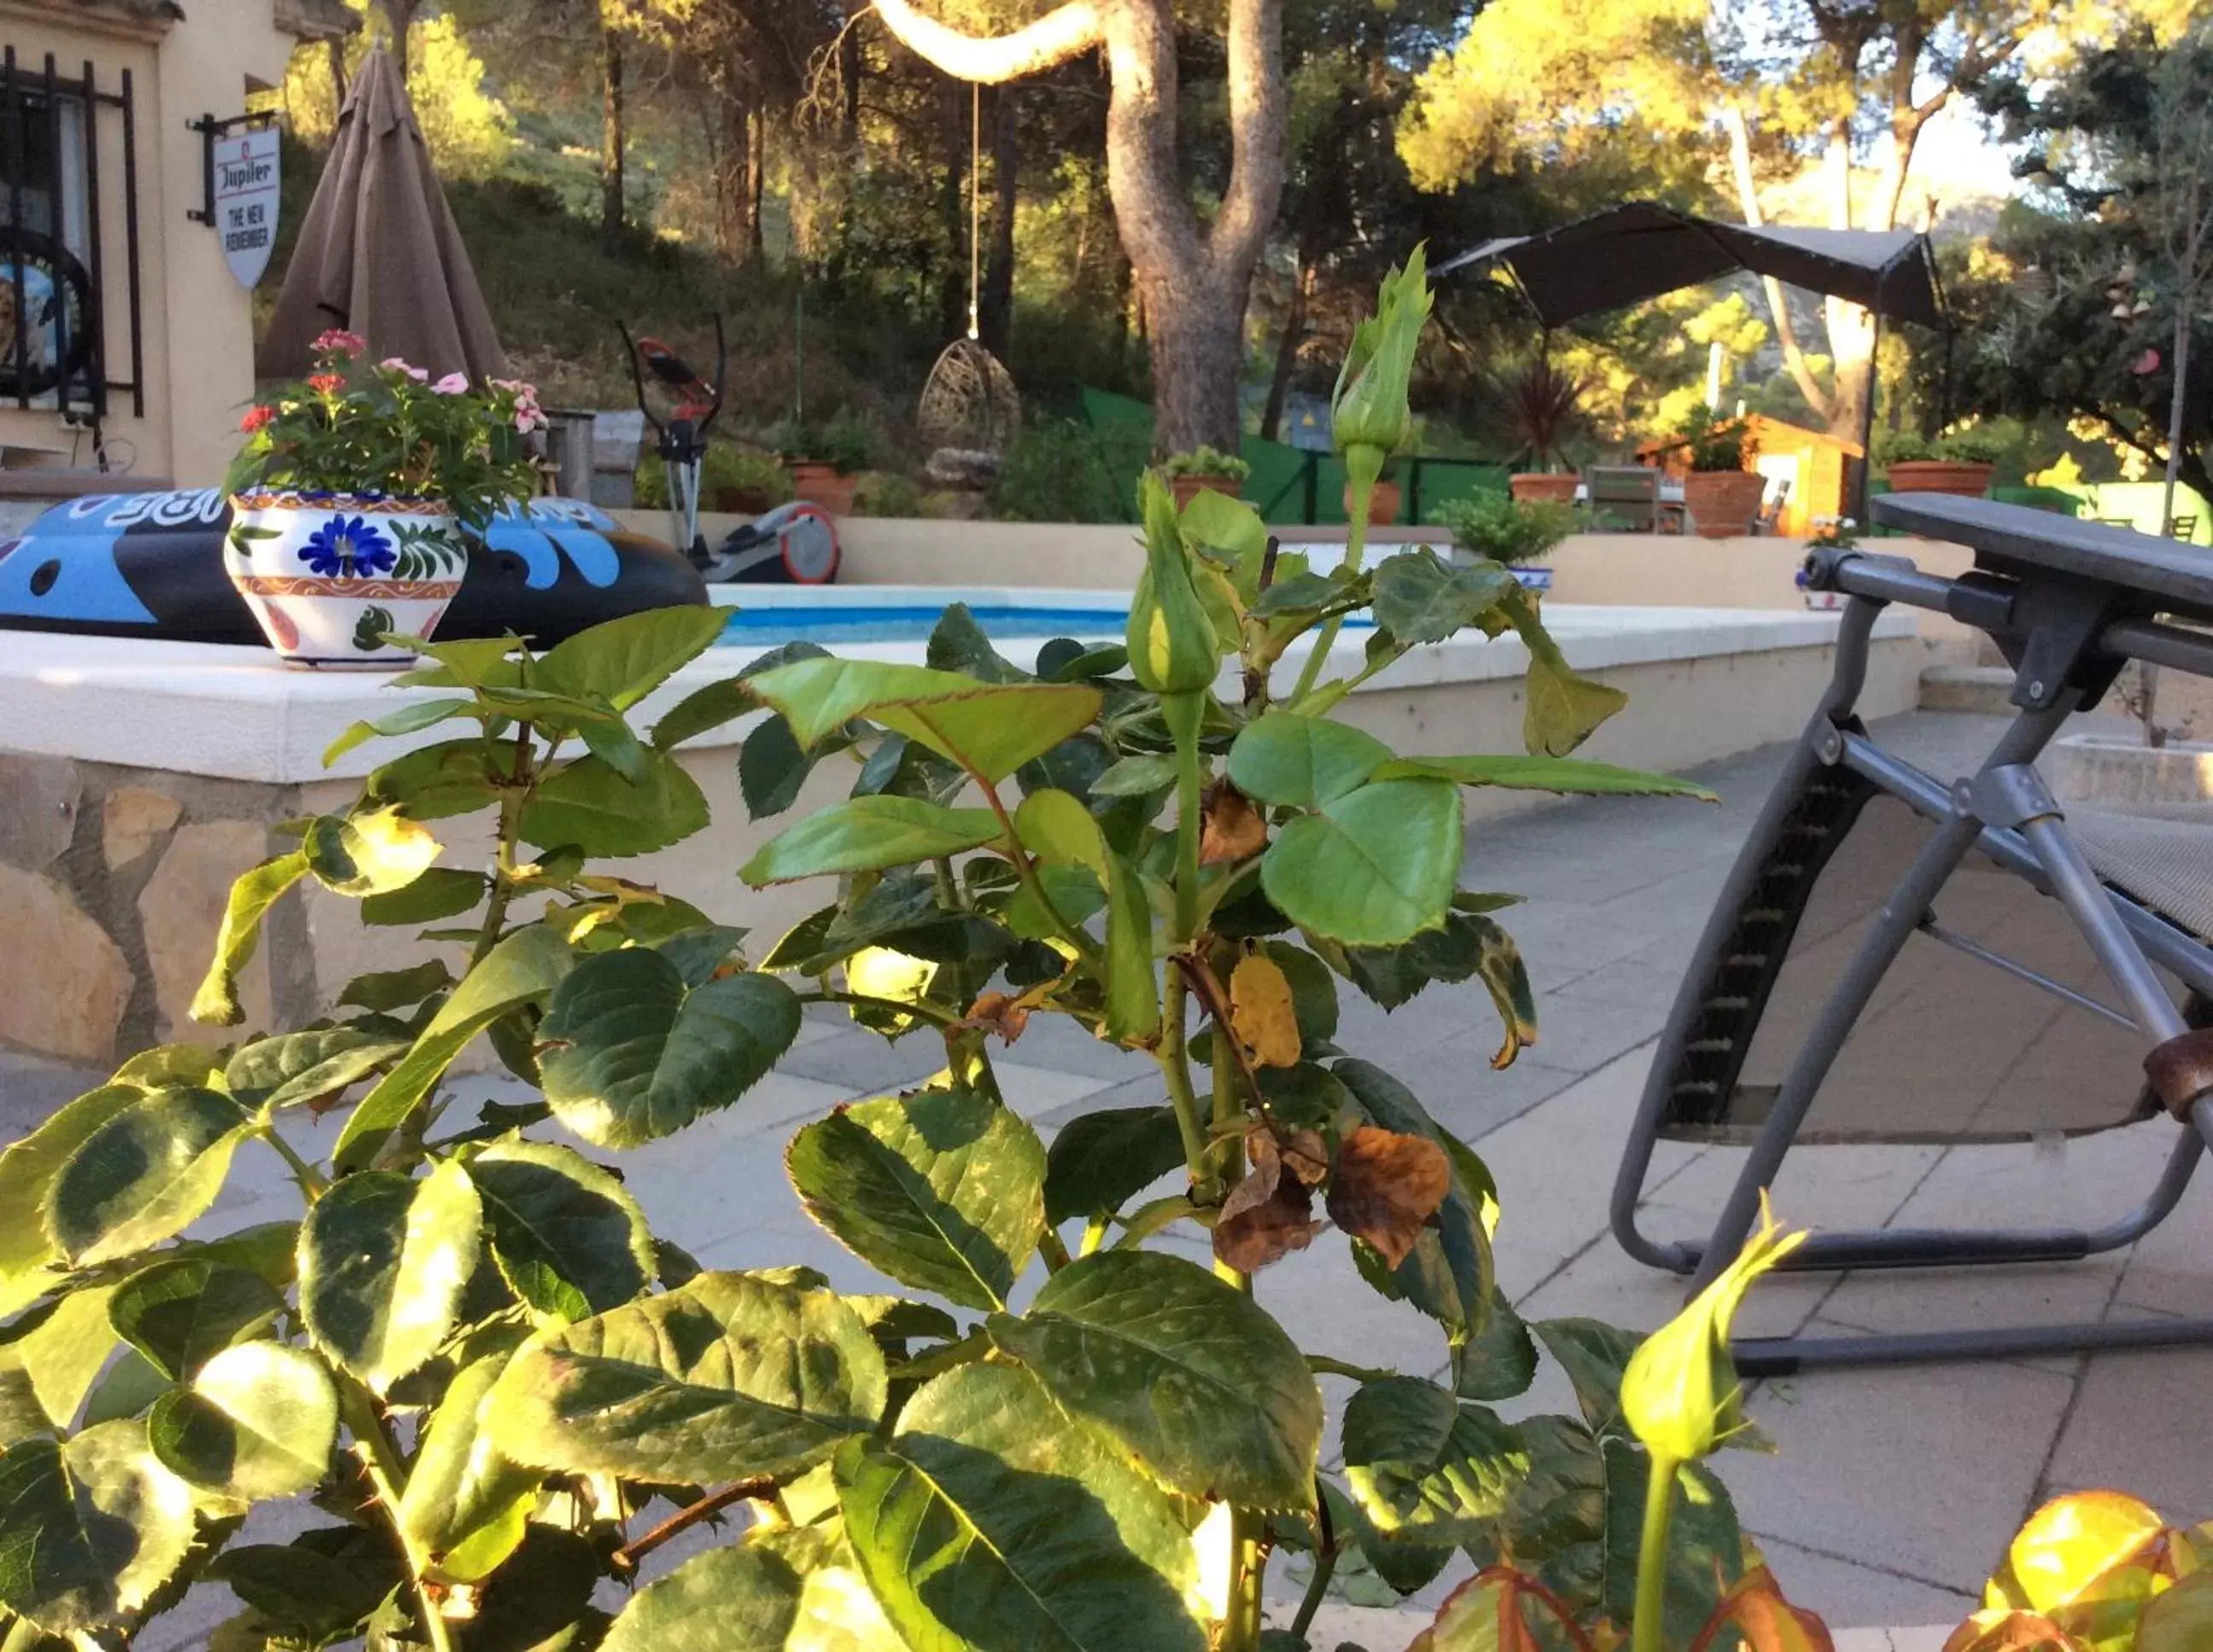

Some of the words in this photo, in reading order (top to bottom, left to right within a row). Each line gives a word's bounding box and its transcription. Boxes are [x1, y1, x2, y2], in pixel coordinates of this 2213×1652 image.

[222, 161, 271, 189] Jupiler
[228, 207, 244, 228] THE
[248, 204, 264, 224] NEW
